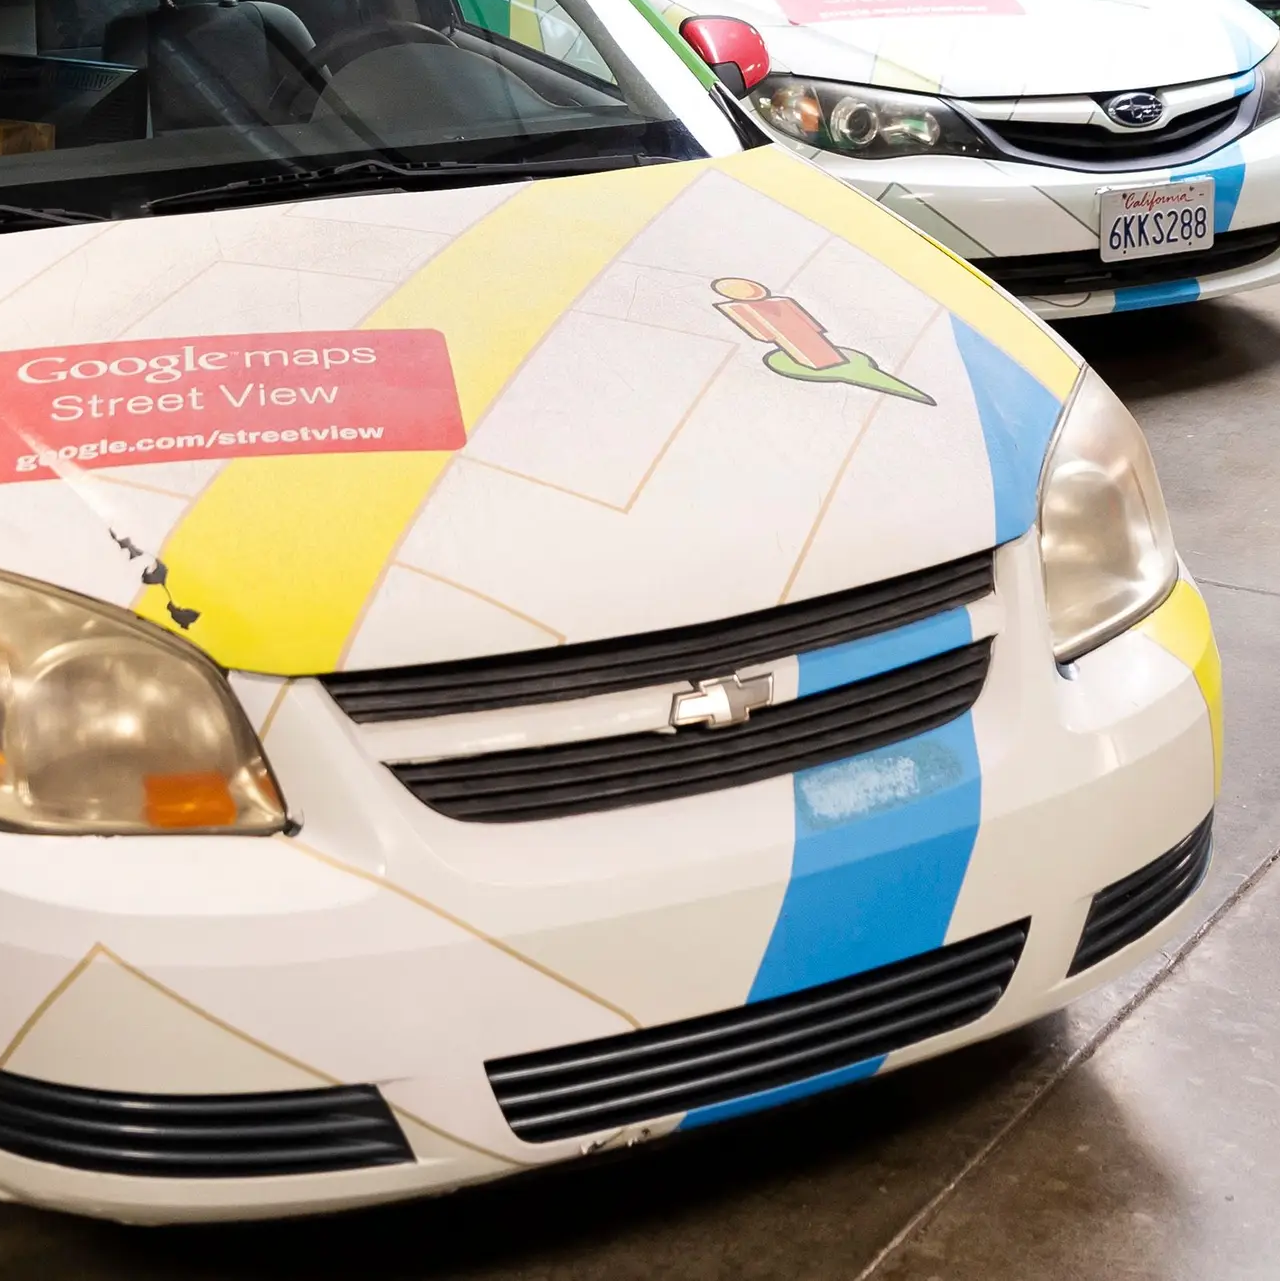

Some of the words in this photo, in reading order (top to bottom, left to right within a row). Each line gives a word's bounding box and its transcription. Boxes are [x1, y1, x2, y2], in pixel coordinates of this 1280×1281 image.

[1125, 190, 1194, 211] California
[1109, 207, 1207, 250] 6KKS288
[17, 345, 229, 384] Google
[244, 347, 377, 370] maps
[50, 386, 204, 422] Street
[219, 383, 339, 408] View
